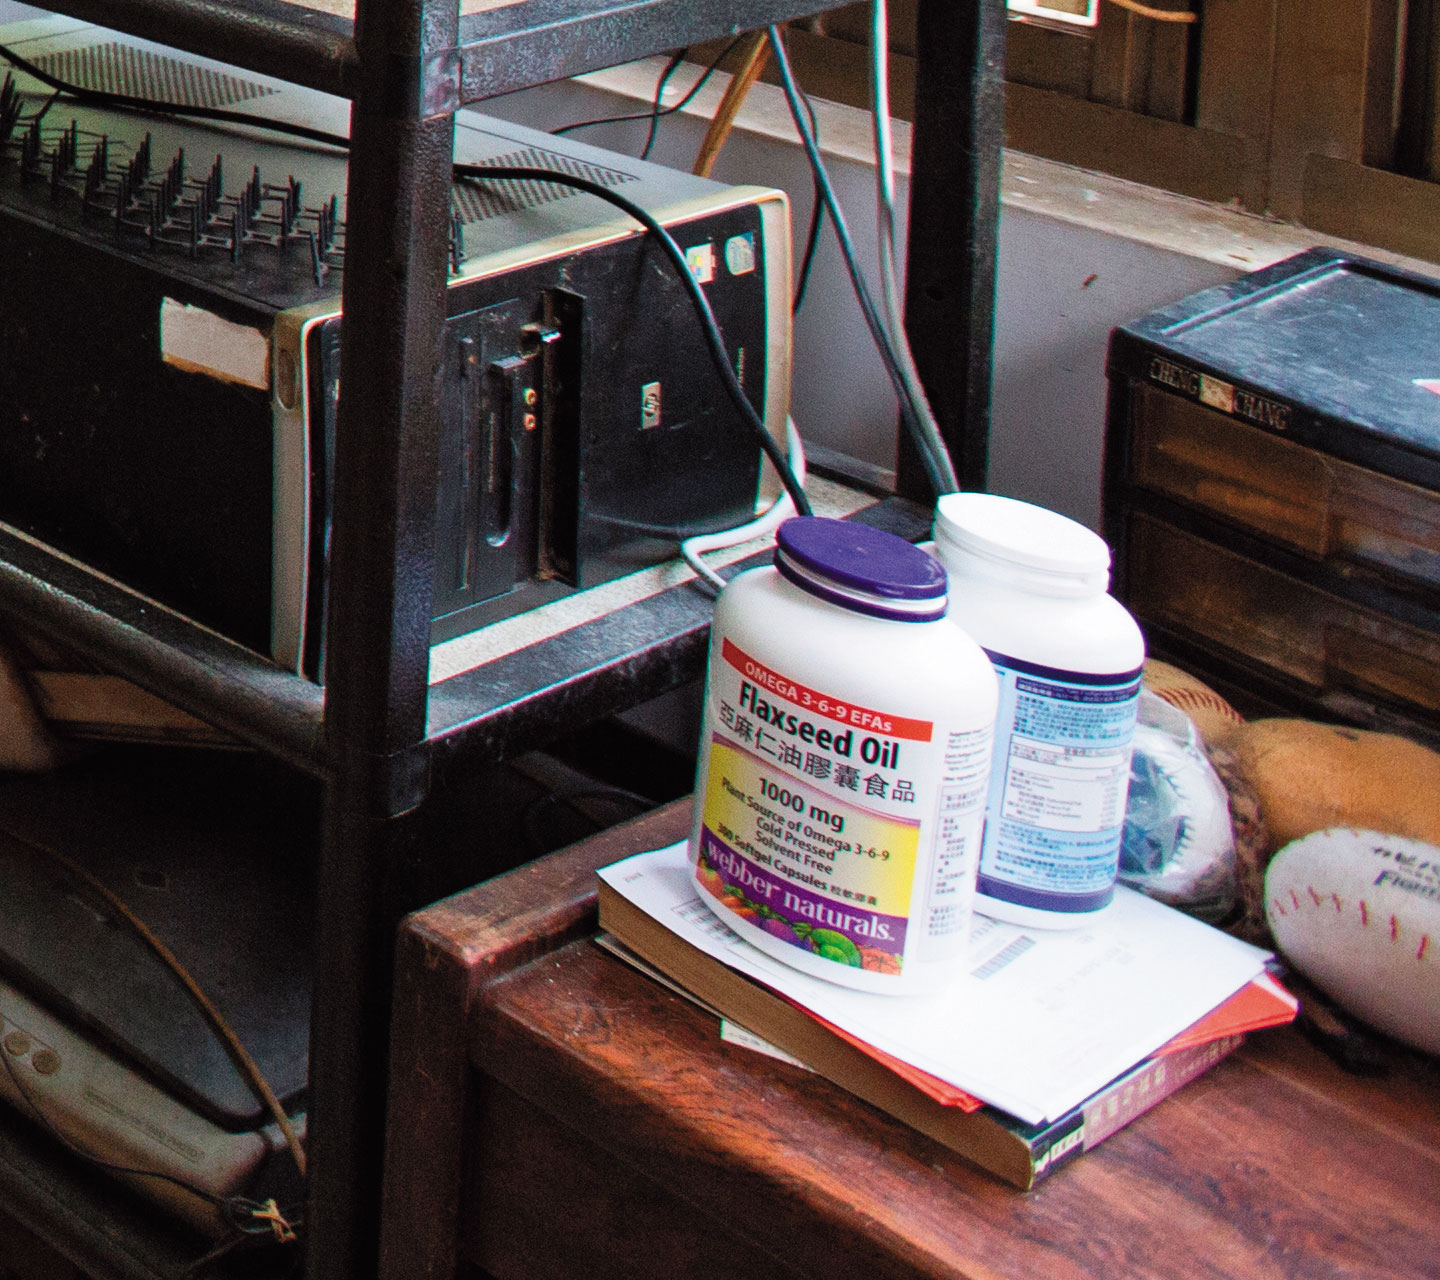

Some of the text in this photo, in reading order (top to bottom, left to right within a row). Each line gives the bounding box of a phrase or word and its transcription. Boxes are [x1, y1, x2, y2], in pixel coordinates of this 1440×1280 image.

[1149, 357, 1200, 395] CHENG
[1234, 390, 1292, 430] CHANG
[738, 681, 854, 758] Flaxseed
[860, 737, 900, 770] Oil
[745, 660, 892, 733] OMEGA 3-6-9 EFAs
[719, 699, 915, 803] 亞麻仁油膠囊食品
[721, 777, 890, 861] Plant Source of Omega 3-6-9
[759, 778, 845, 833] 1000 mg
[708, 838, 781, 901] webber
[734, 828, 774, 867] Softgel
[774, 854, 828, 892] Capsules
[756, 816, 836, 862] Cold Pressed
[756, 828, 833, 875] Solvent Free
